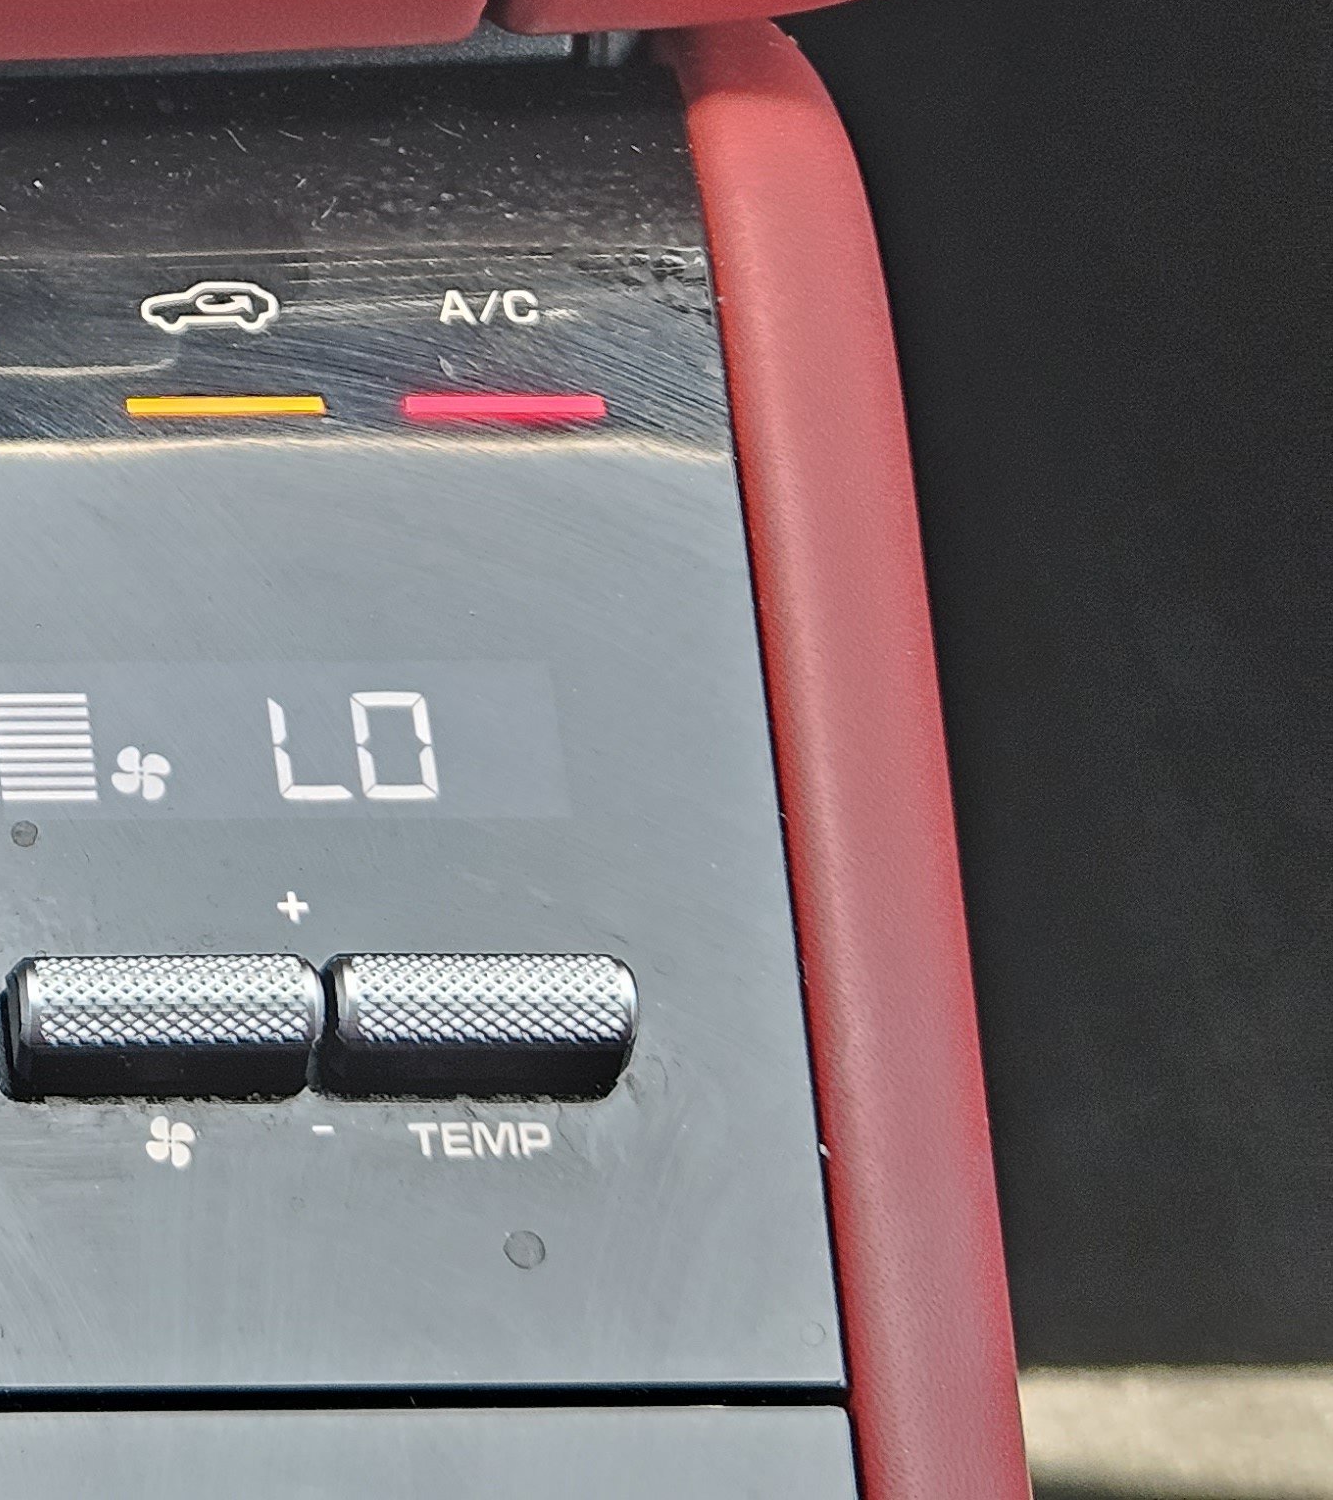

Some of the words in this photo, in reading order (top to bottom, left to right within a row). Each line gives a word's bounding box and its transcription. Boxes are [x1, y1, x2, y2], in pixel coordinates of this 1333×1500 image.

[439, 289, 540, 325] A/C
[267, 691, 440, 802] LO
[407, 1121, 552, 1159] TEMP
